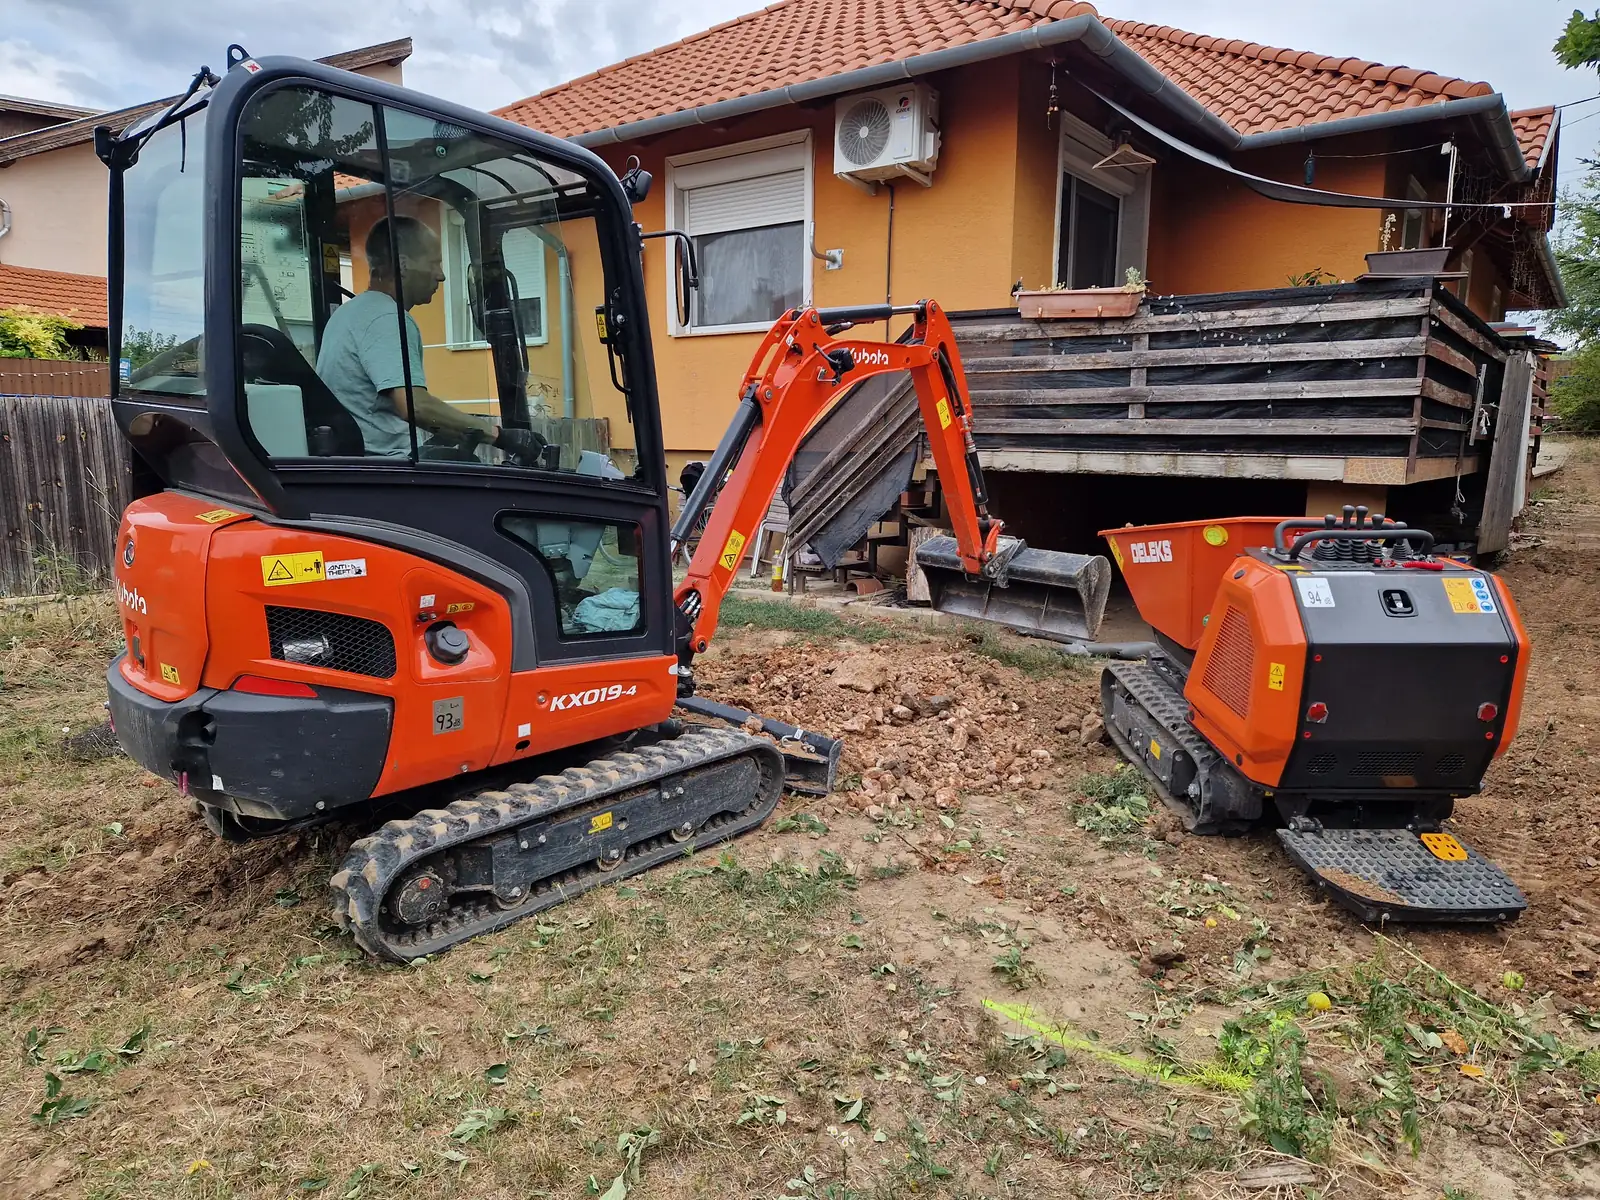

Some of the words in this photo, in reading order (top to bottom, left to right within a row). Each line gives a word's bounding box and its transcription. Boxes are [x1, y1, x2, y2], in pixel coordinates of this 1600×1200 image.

[1130, 540, 1173, 564] DELEKS
[327, 568, 351, 576] THEFT
[1307, 591, 1322, 605] 94
[549, 684, 637, 712] KX019-4
[436, 712, 453, 730] 93
